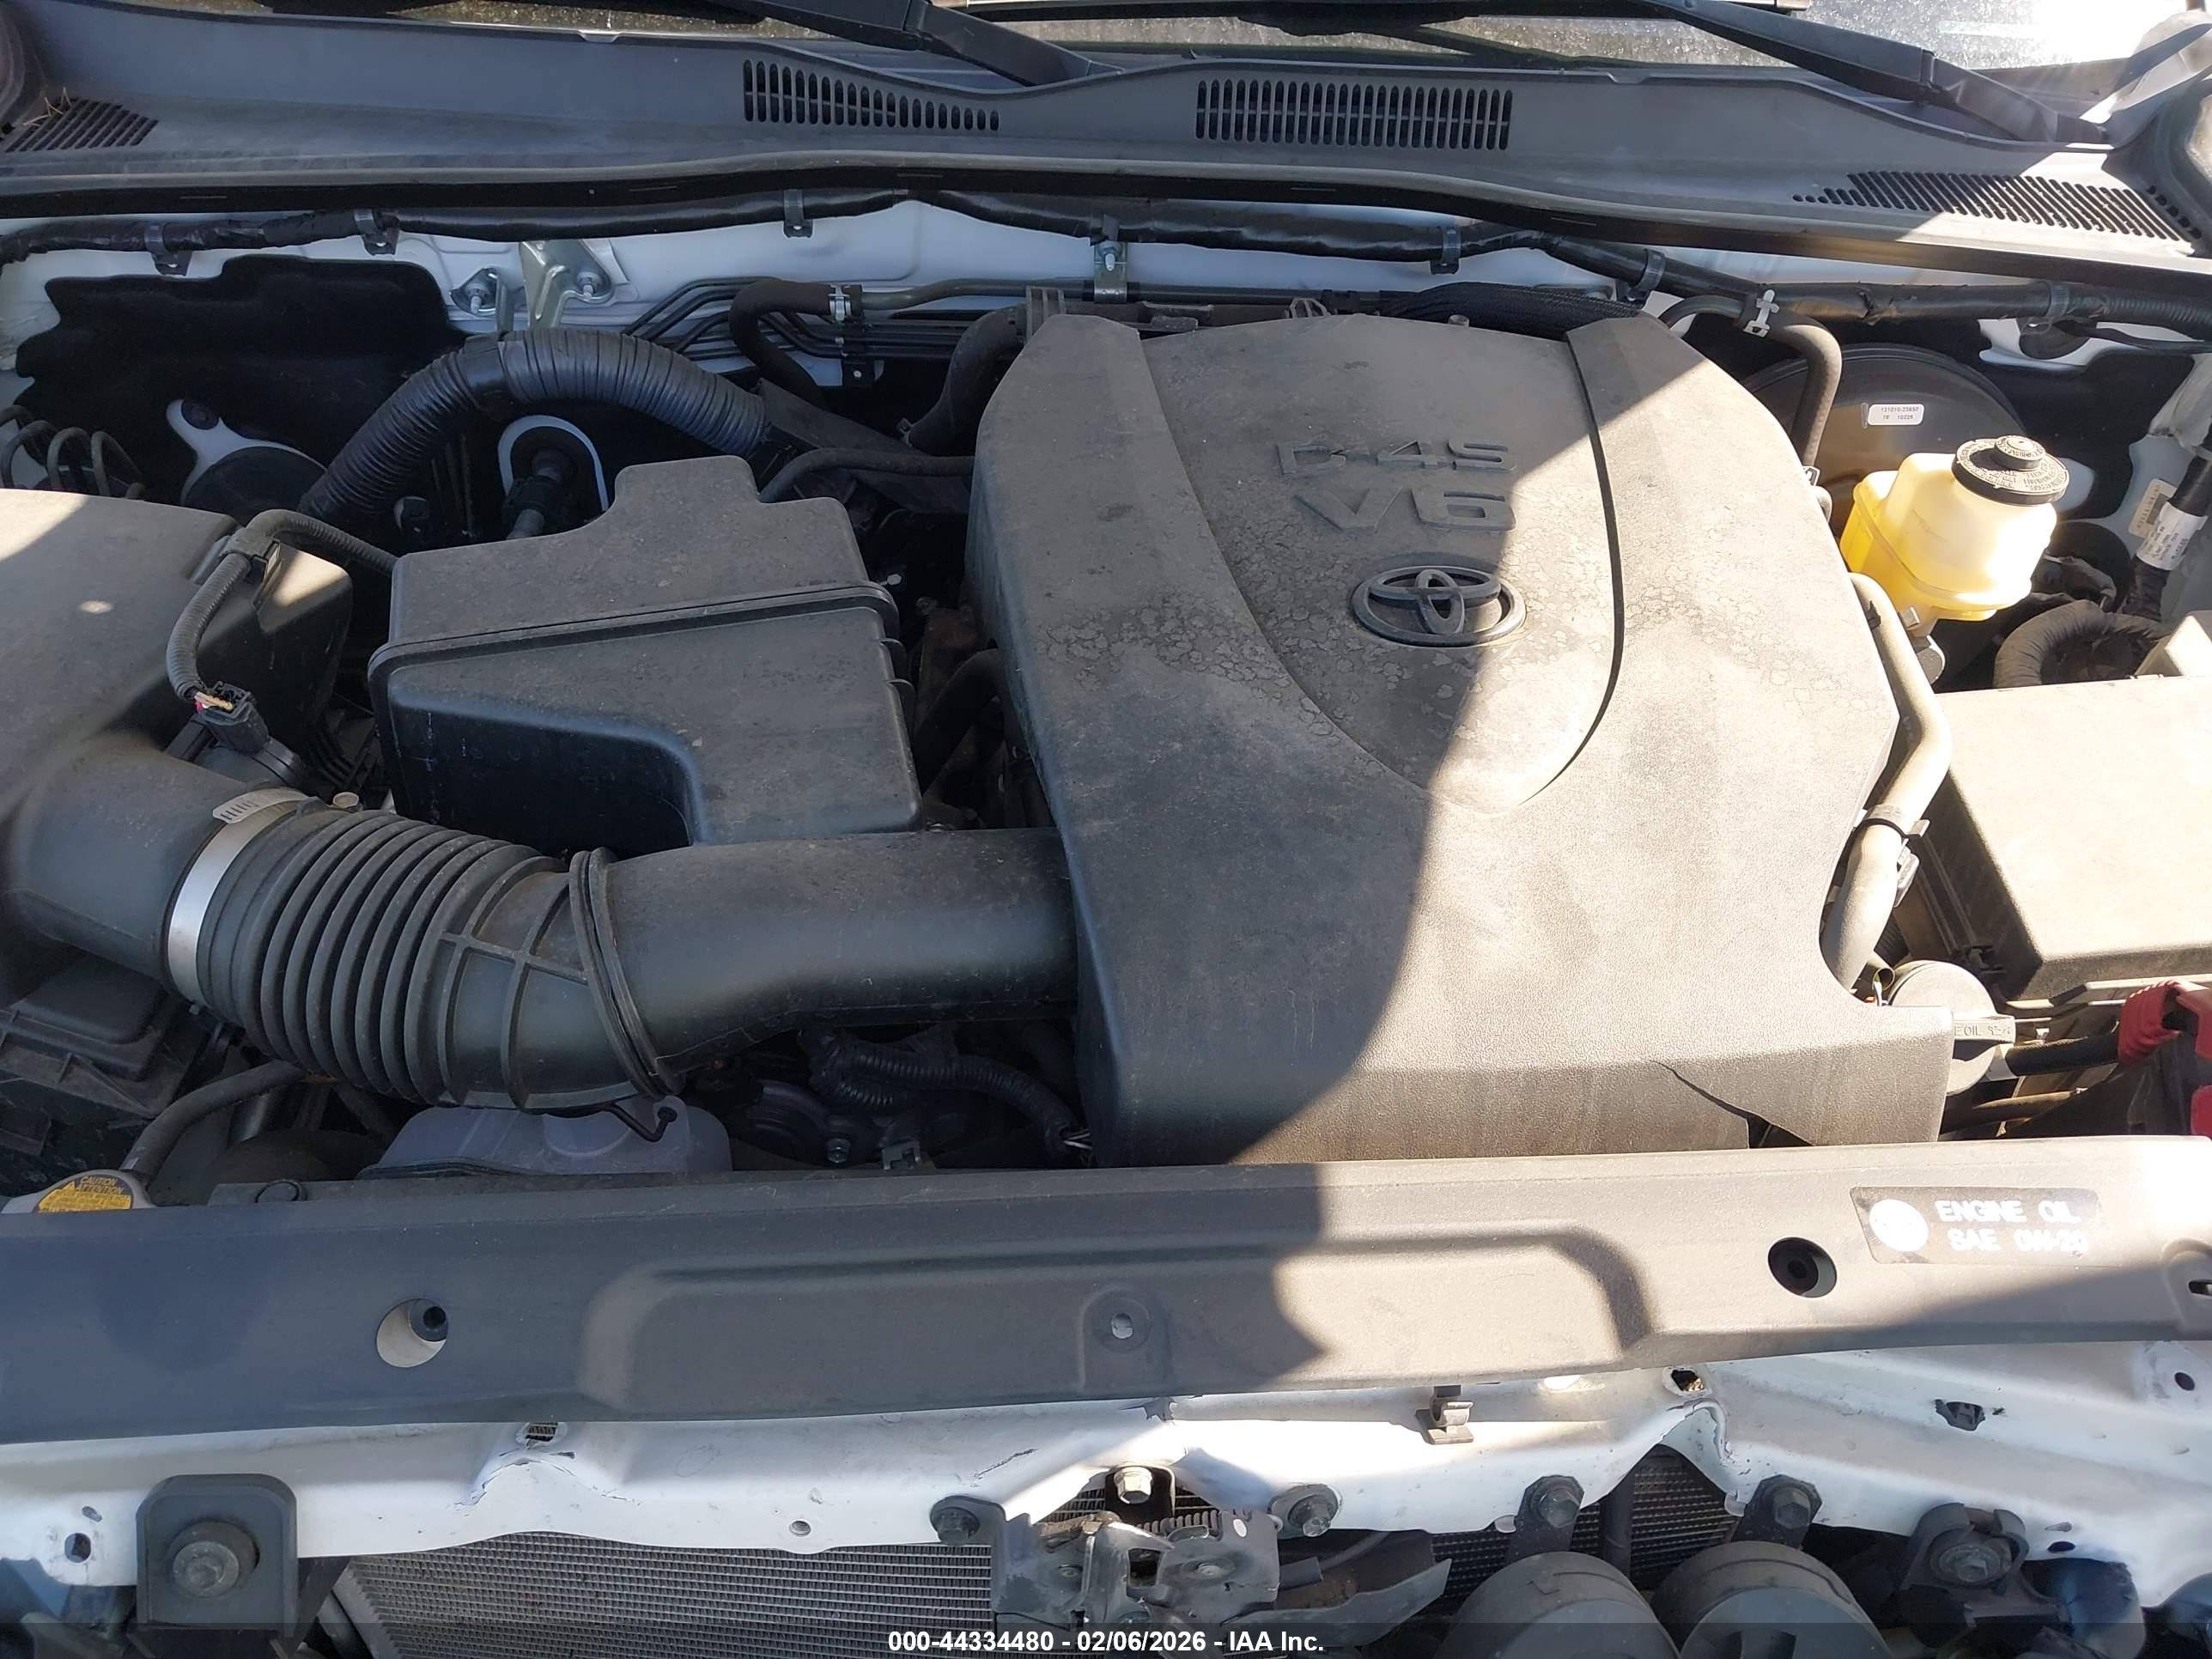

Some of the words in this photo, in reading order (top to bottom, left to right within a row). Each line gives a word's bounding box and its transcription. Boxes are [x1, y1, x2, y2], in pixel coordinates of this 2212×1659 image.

[1292, 485, 1518, 533] V6
[75, 1183, 125, 1194] ATTENTION
[81, 1176, 118, 1186] CAUTION
[1935, 1200, 2027, 1223] ENGINE
[2038, 1200, 2082, 1223] OIL
[1947, 1228, 2001, 1251] SAE
